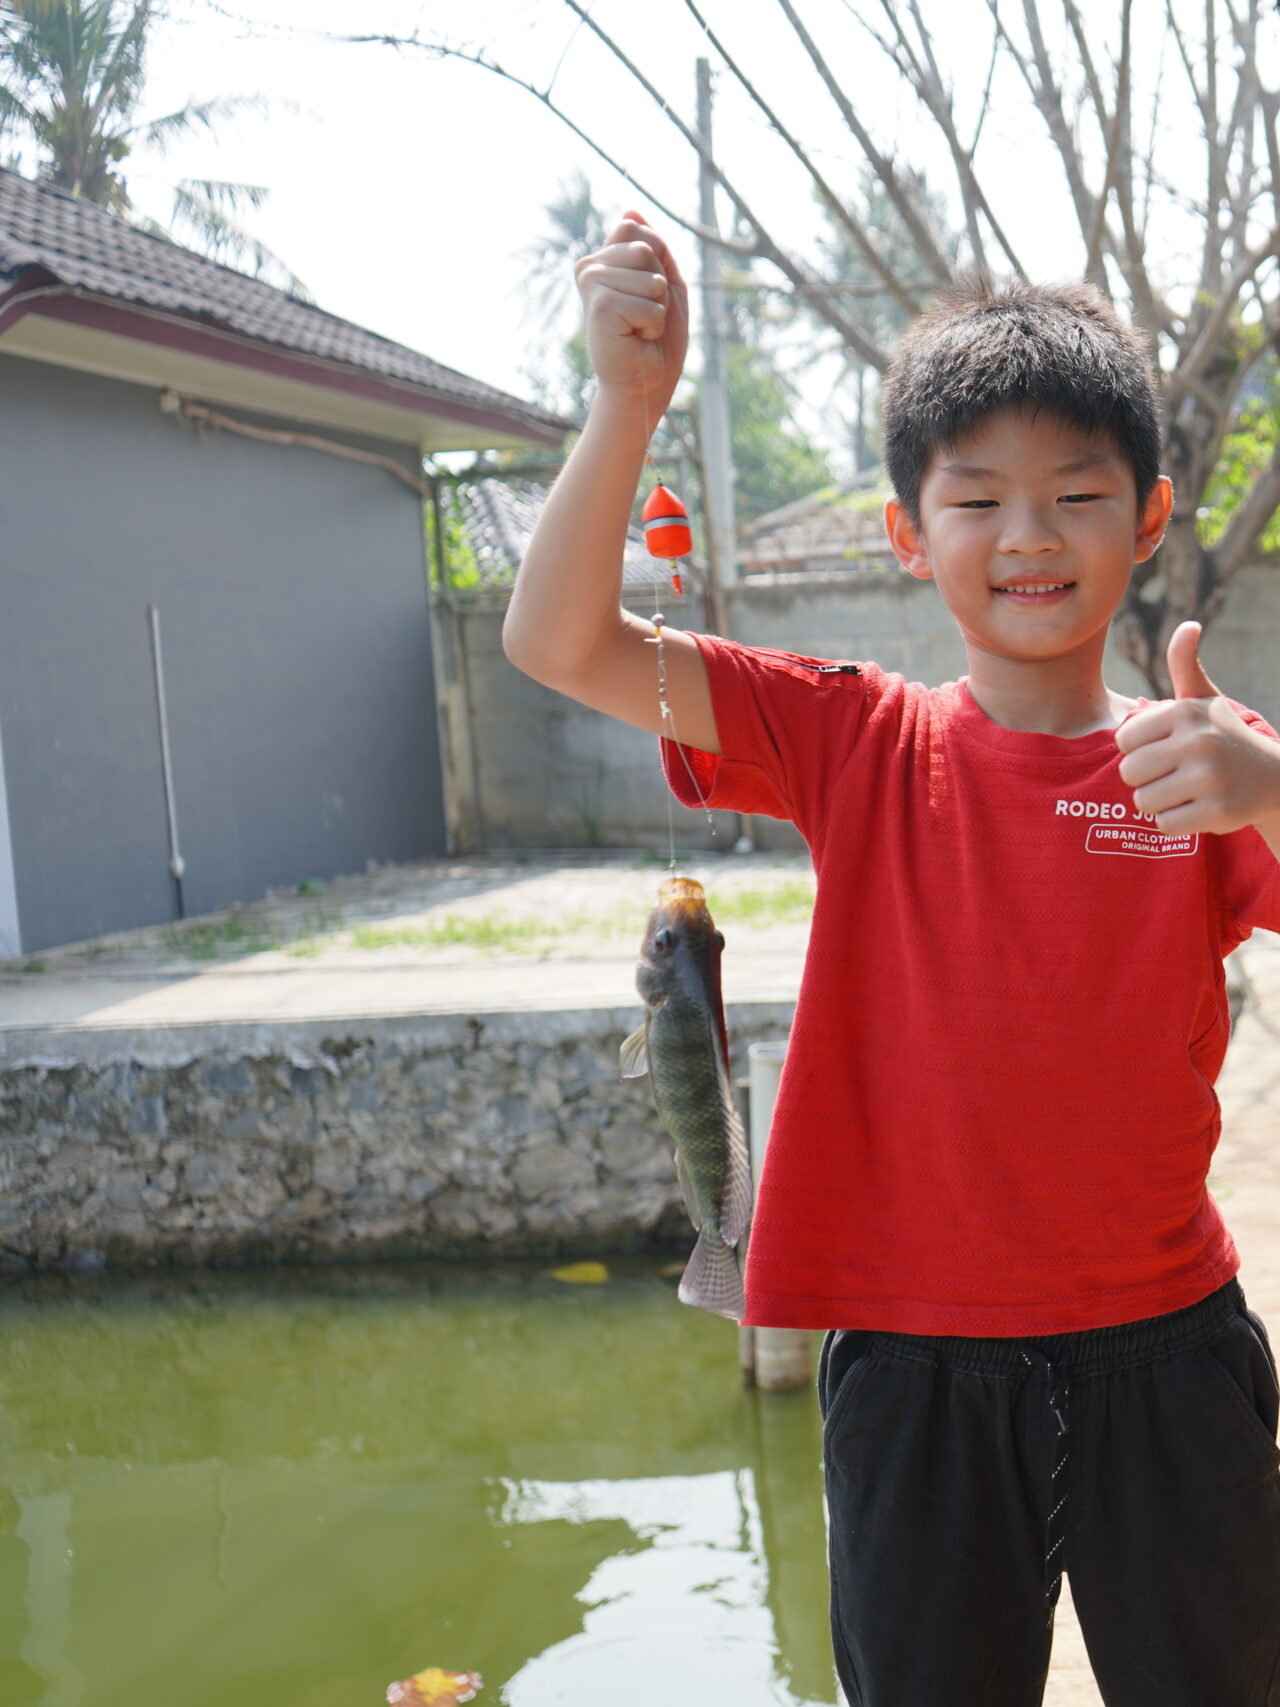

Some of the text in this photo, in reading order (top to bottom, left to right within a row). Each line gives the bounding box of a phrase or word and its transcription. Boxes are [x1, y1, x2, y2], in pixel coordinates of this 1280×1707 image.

[1055, 799, 1127, 819] RODEO
[1095, 829, 1191, 845] URBAN CLOTHING
[1121, 841, 1191, 853] ORIGINAL BRAND
